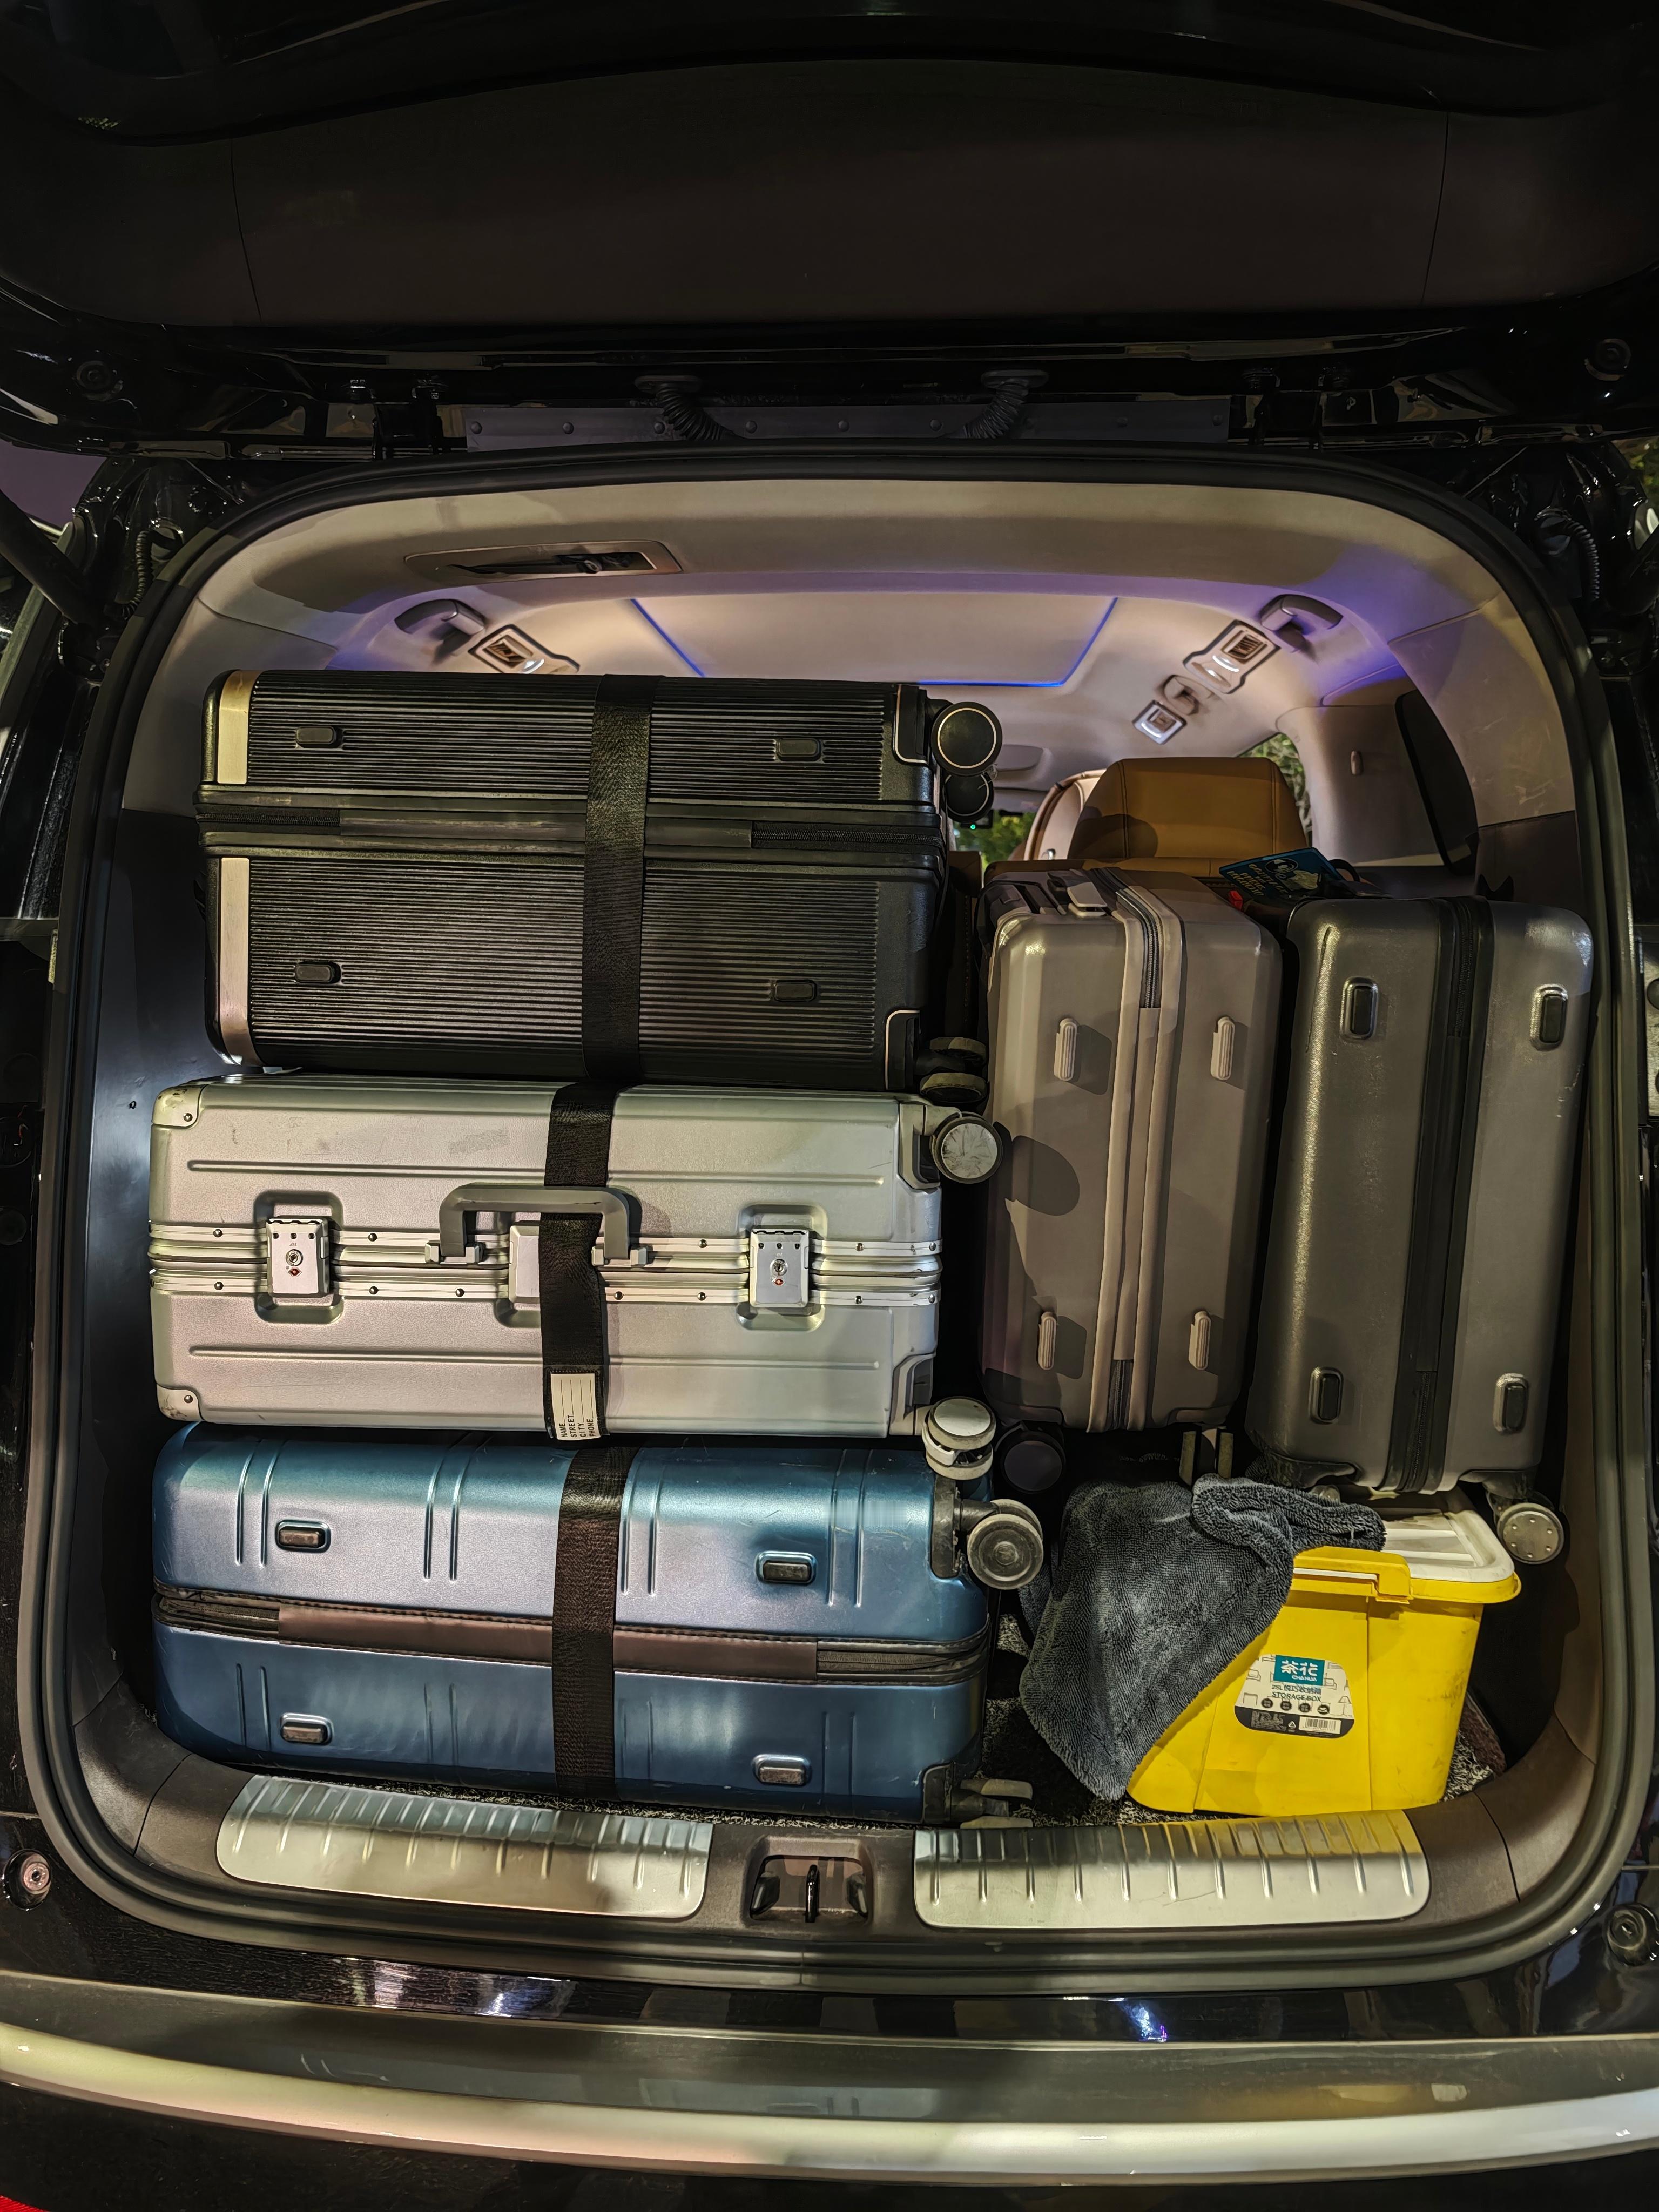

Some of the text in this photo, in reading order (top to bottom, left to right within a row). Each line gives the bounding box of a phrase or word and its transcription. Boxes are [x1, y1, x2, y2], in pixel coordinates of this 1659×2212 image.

[559, 1423, 568, 1438] NAME
[567, 1414, 577, 1438] STREET
[578, 1422, 586, 1437] CITY
[586, 1419, 596, 1437] PHONE
[1280, 1660, 1318, 1676] 茶花
[1272, 1691, 1306, 1700] STORAGE
